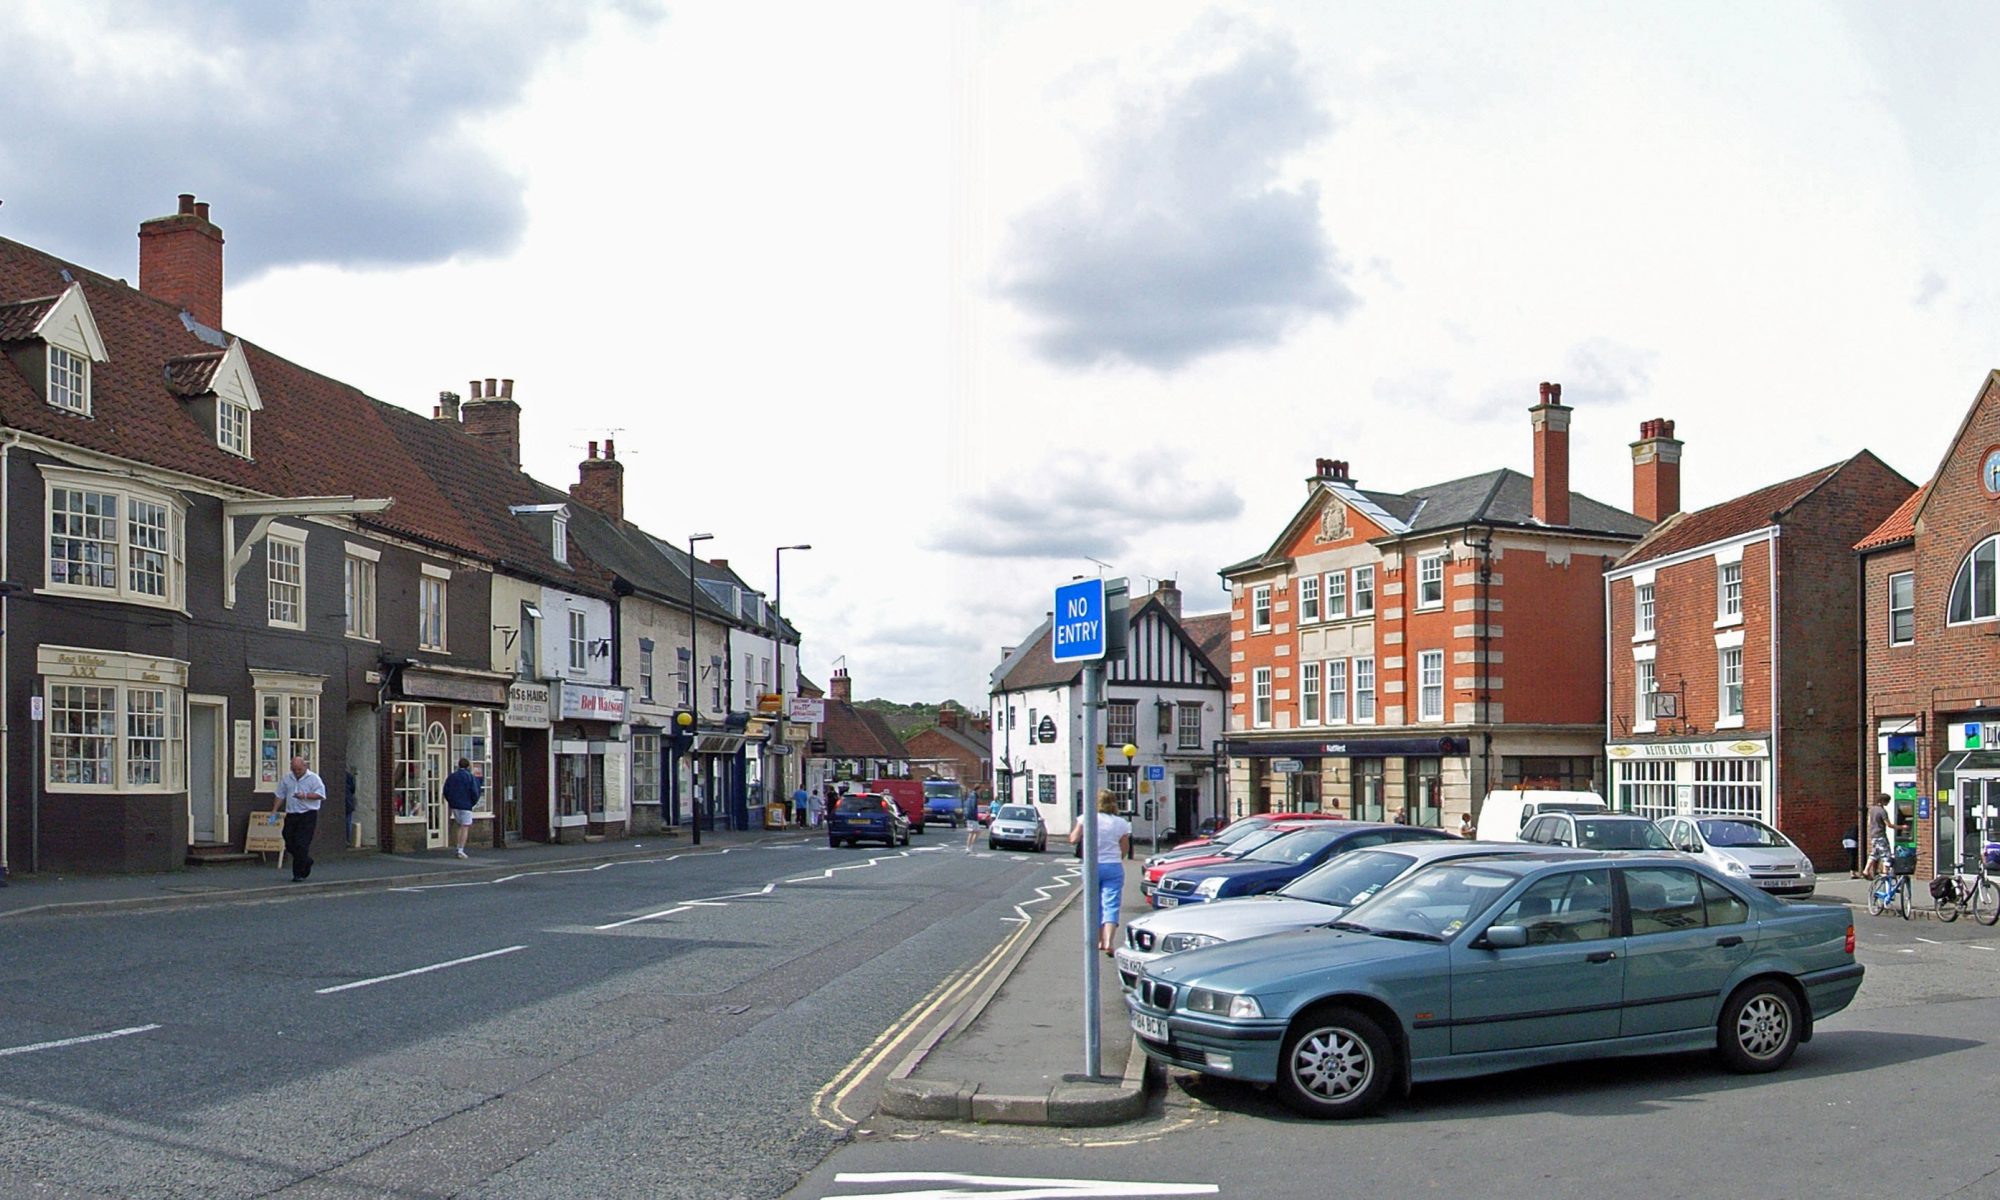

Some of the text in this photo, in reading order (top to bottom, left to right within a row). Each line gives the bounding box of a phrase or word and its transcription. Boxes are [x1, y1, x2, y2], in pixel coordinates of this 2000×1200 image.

[1068, 596, 1087, 618] NO
[1058, 620, 1099, 645] ENTRY
[526, 690, 548, 703] HAIRS
[580, 694, 597, 711] Bell
